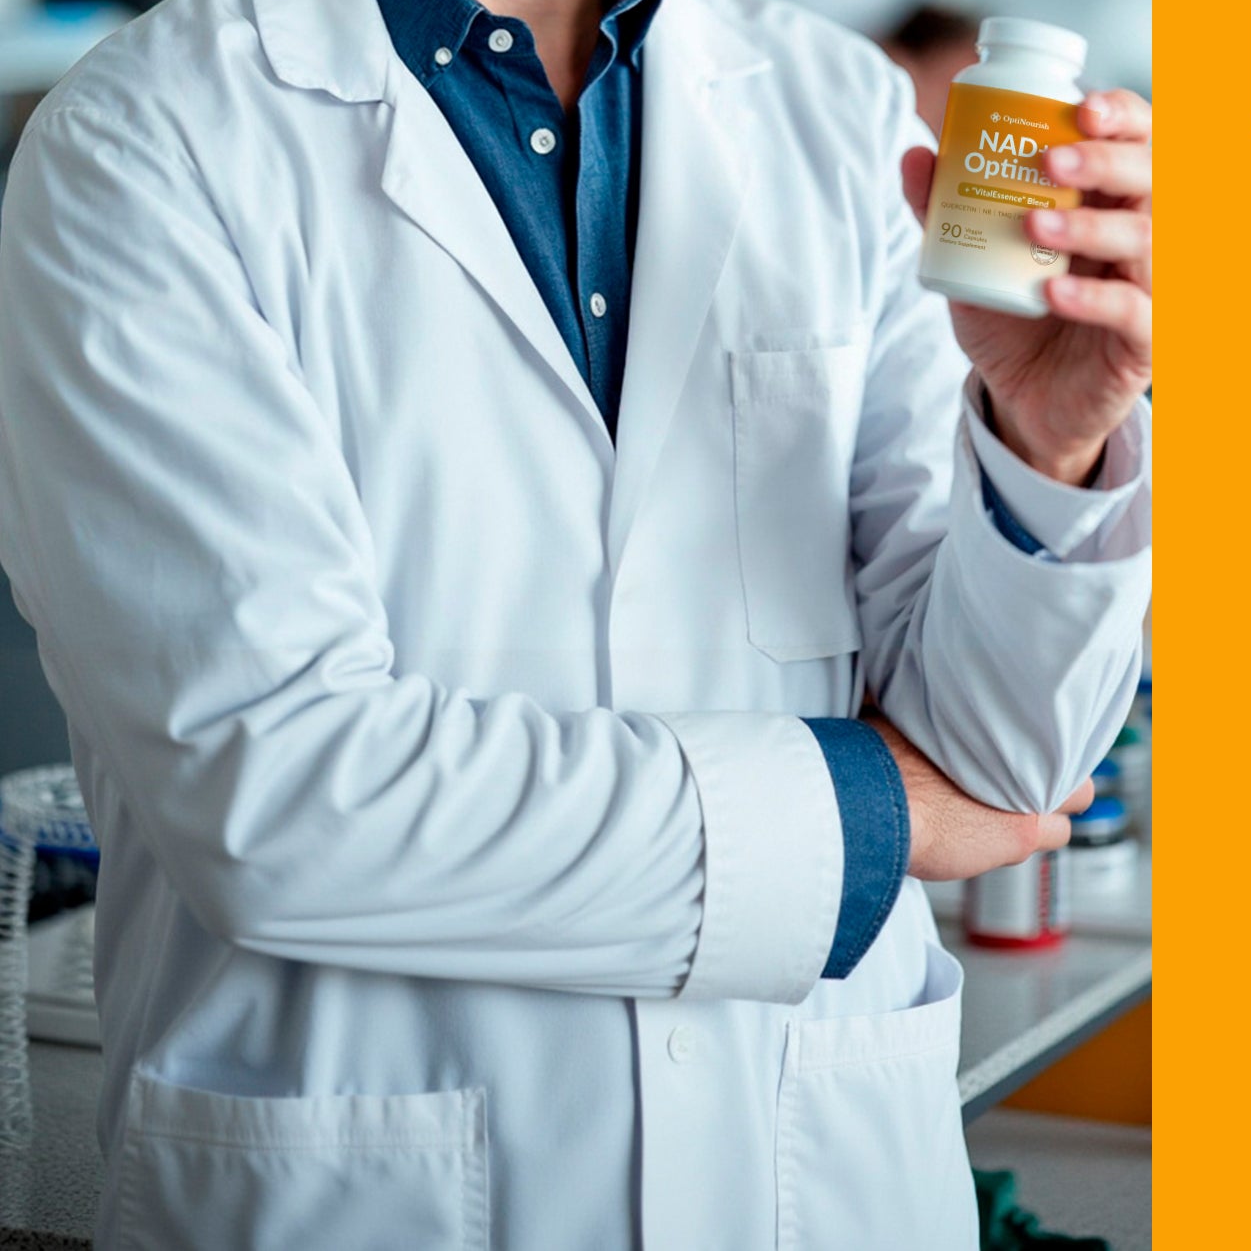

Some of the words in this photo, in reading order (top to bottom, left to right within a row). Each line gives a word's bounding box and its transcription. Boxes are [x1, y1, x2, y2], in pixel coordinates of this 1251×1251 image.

[1003, 115, 1049, 129] OptiNourish
[964, 152, 1057, 187] Optima
[1027, 197, 1049, 208] Blend
[941, 222, 961, 238] 90
